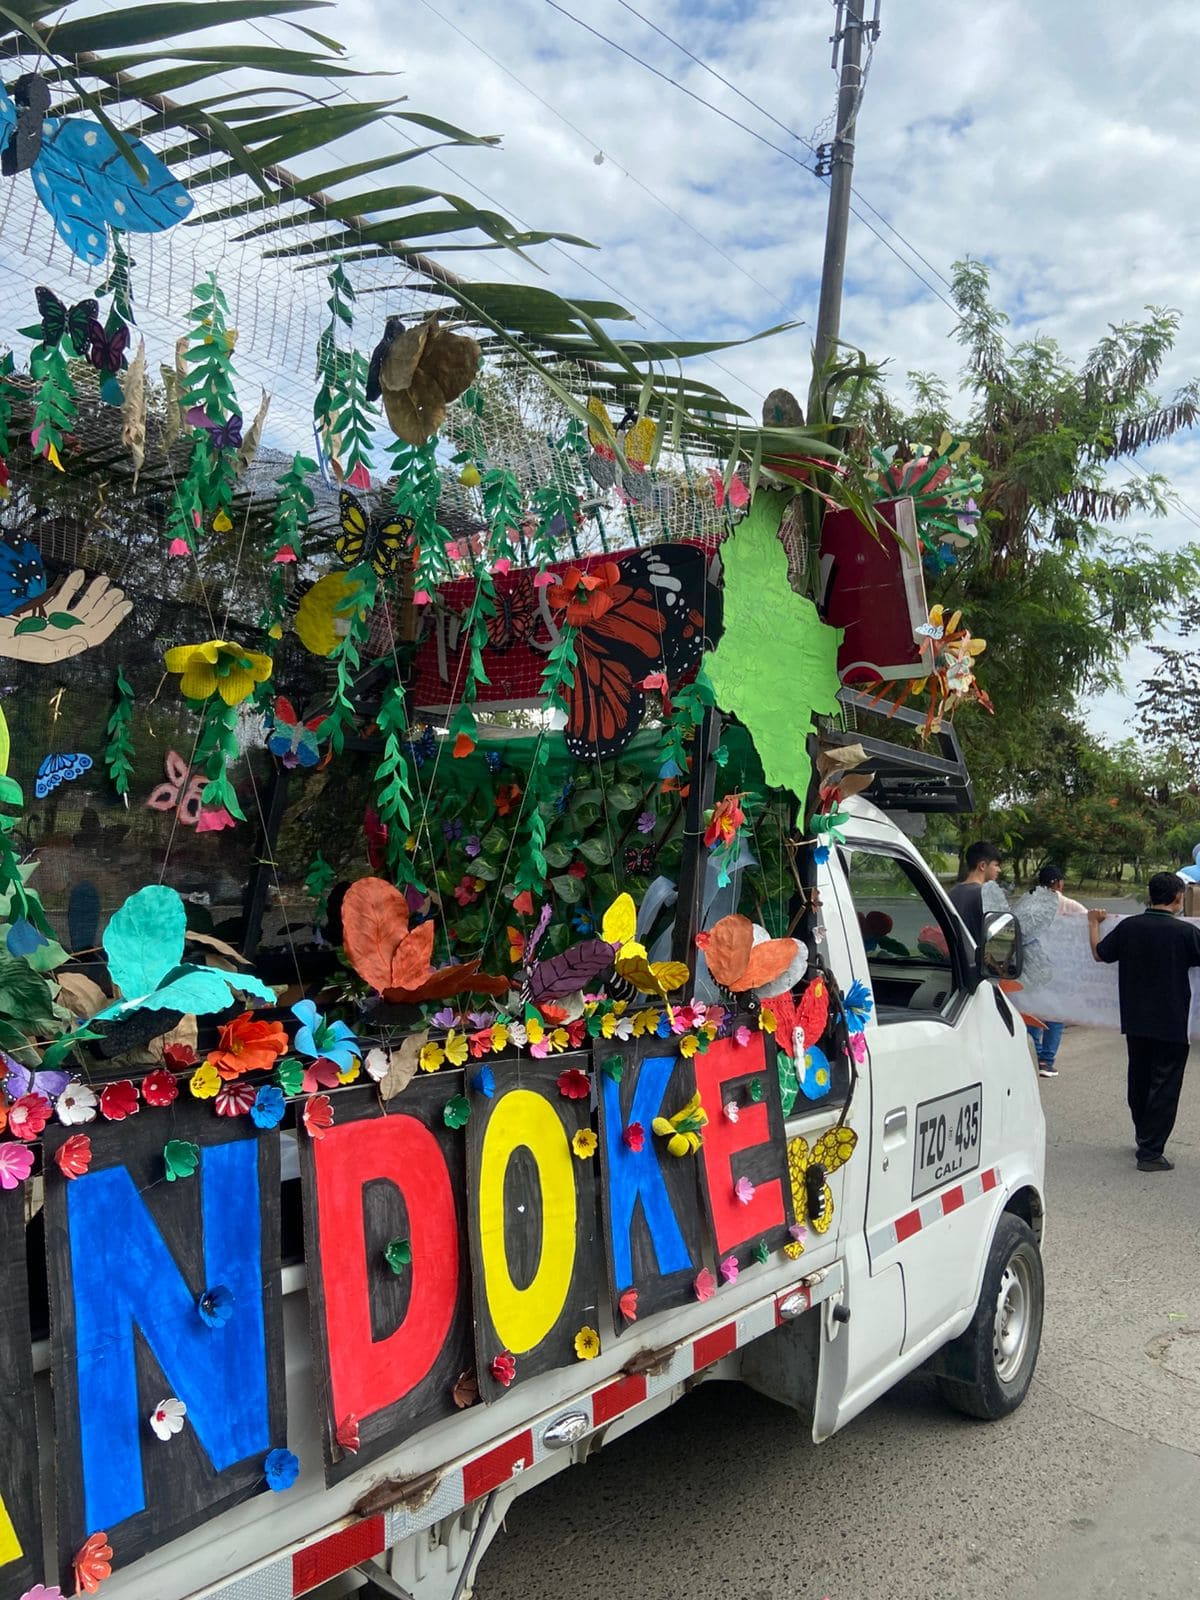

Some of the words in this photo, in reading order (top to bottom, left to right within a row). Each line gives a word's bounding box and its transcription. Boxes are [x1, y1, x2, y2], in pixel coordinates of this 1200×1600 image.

[955, 1101, 979, 1152] 435
[934, 1156, 962, 1180] CALI
[0, 1032, 786, 1567] NDOKE
